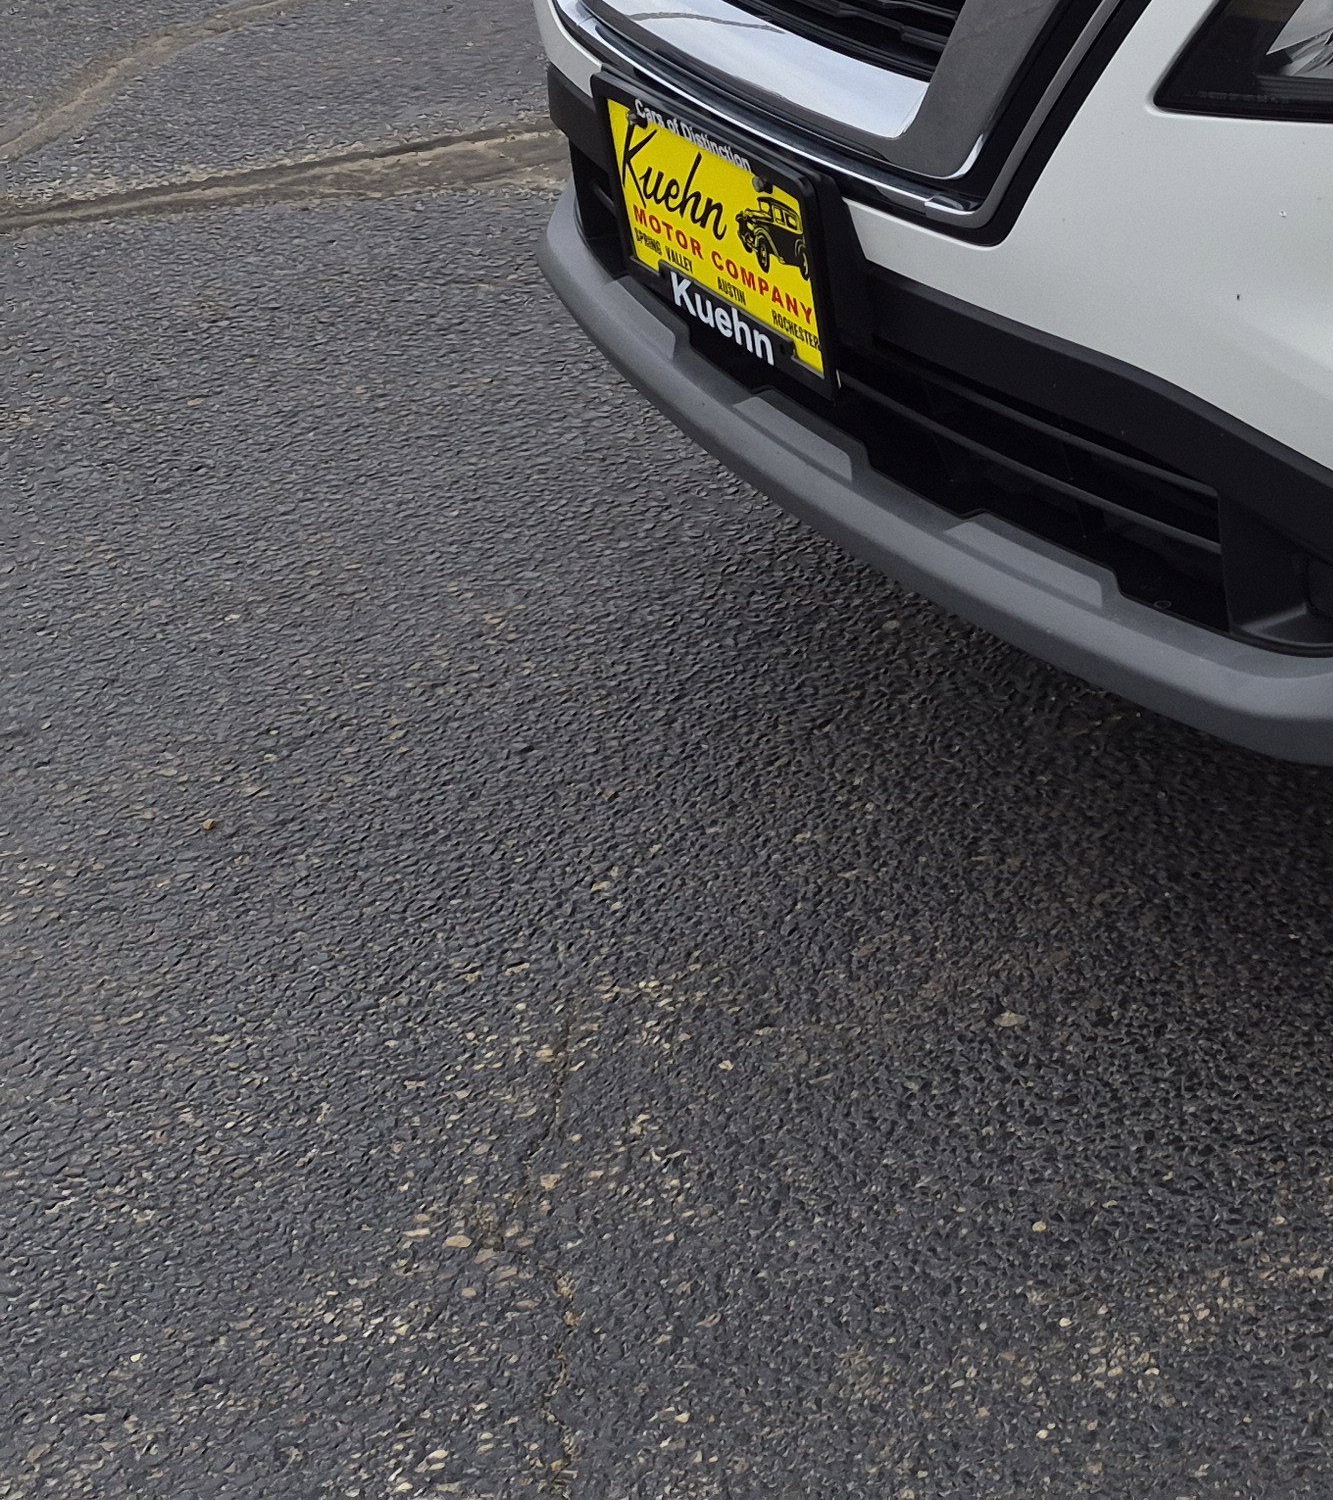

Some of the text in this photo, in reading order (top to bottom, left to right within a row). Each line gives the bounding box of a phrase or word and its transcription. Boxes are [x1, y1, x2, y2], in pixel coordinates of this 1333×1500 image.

[622, 122, 728, 241] Kuehn
[634, 98, 750, 171] Cars of Distinction
[633, 204, 814, 325] MOTOR COMPANY
[633, 226, 821, 351] SPRING VALLEY AUSTIN ROCHESTER
[670, 271, 775, 366] Kuehn
